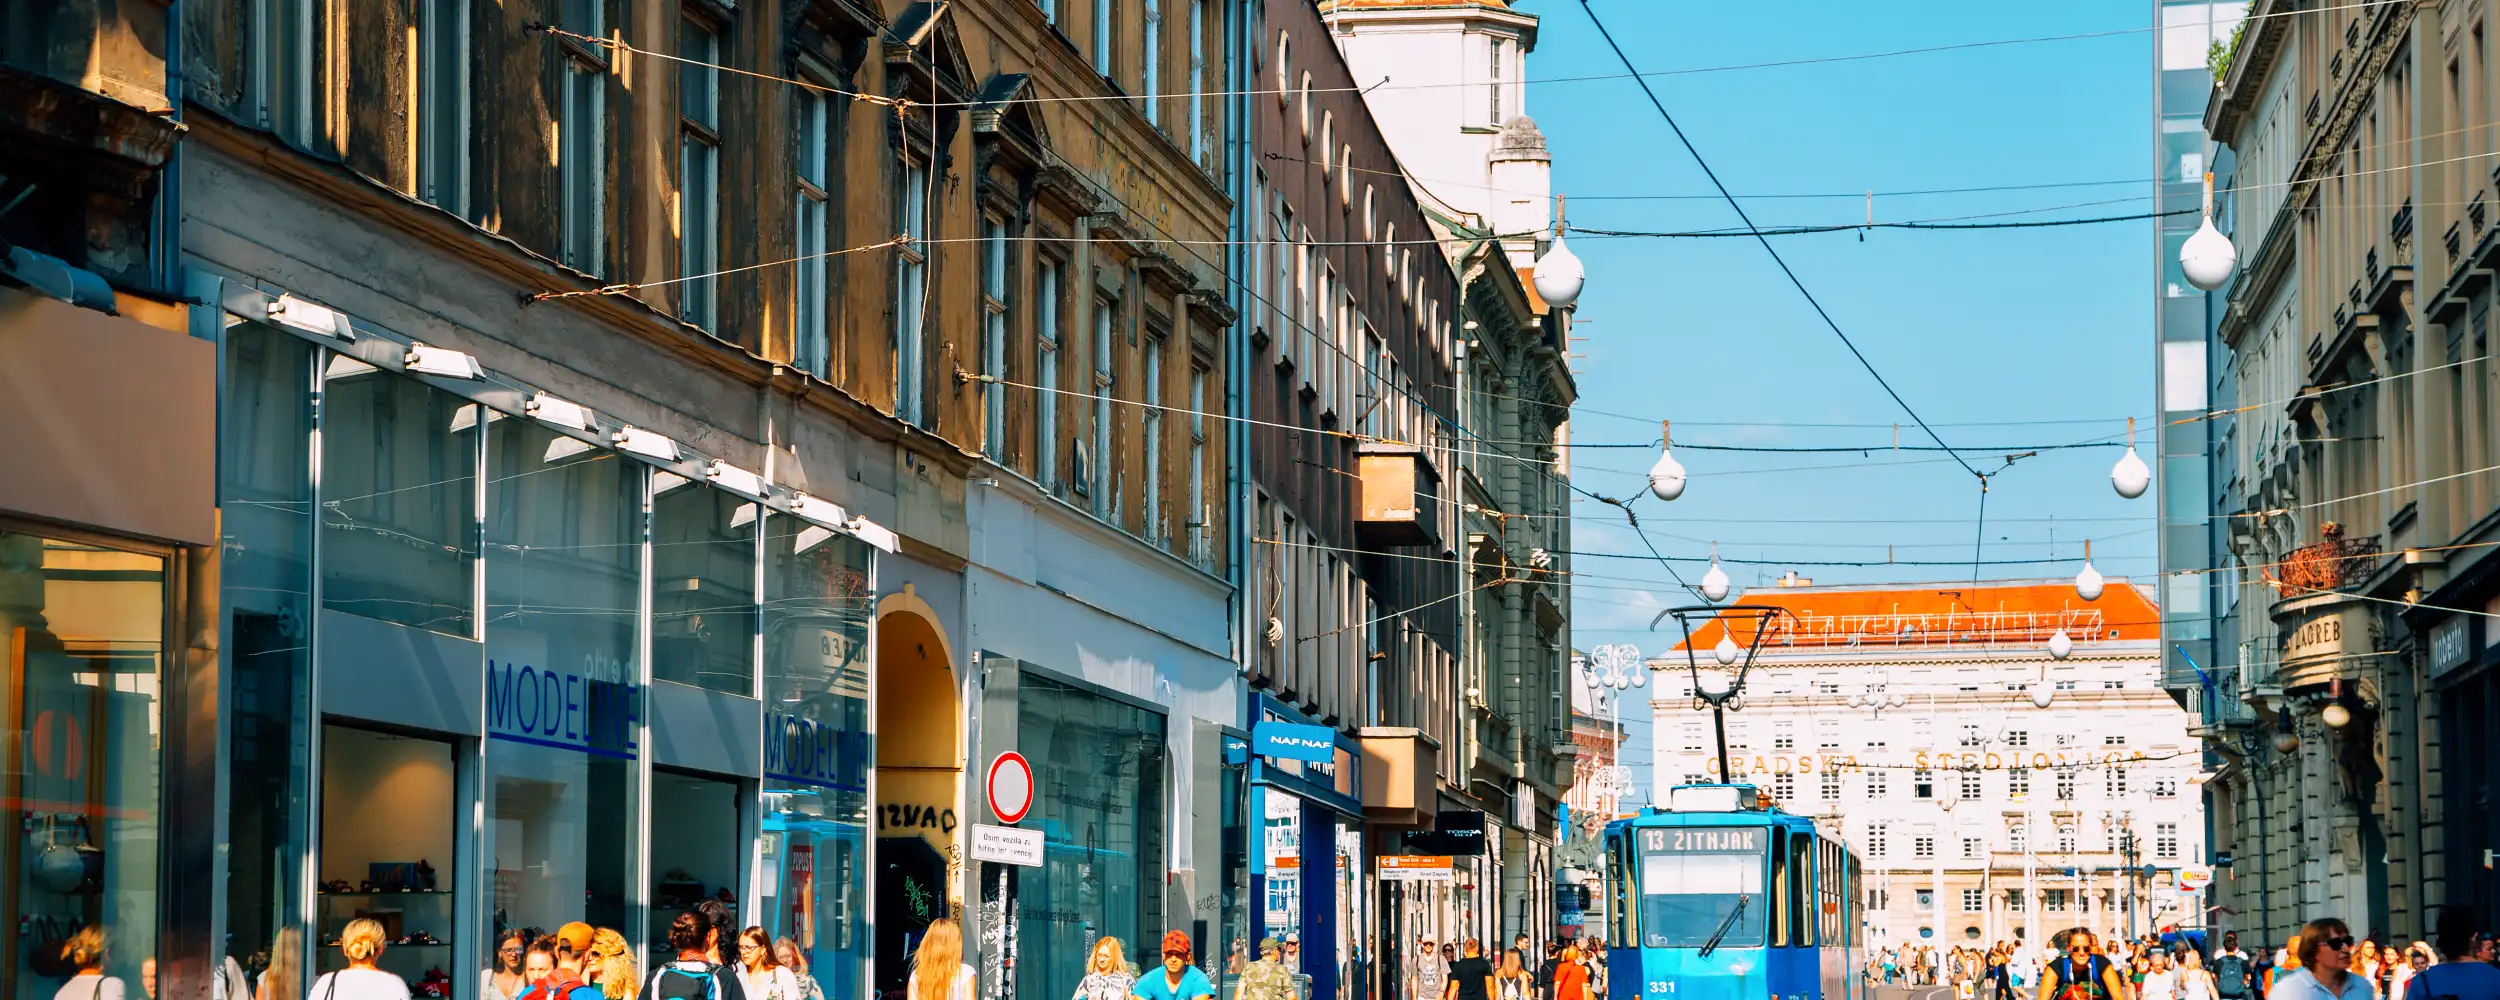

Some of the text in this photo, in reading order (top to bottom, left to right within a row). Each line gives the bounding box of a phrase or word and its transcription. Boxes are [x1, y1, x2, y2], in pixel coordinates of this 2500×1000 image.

[2295, 620, 2341, 650] ZAGREB
[2434, 621, 2464, 669] roberto
[488, 659, 638, 750] MODELINE
[764, 712, 867, 785] MODELINE
[1270, 735, 1332, 749] NAF NAF
[1706, 754, 1862, 775] GRADSKA
[983, 833, 1000, 844] Osim
[1002, 836, 1022, 845] vozila
[1646, 830, 1664, 851] 13
[1649, 981, 1676, 993] 331
